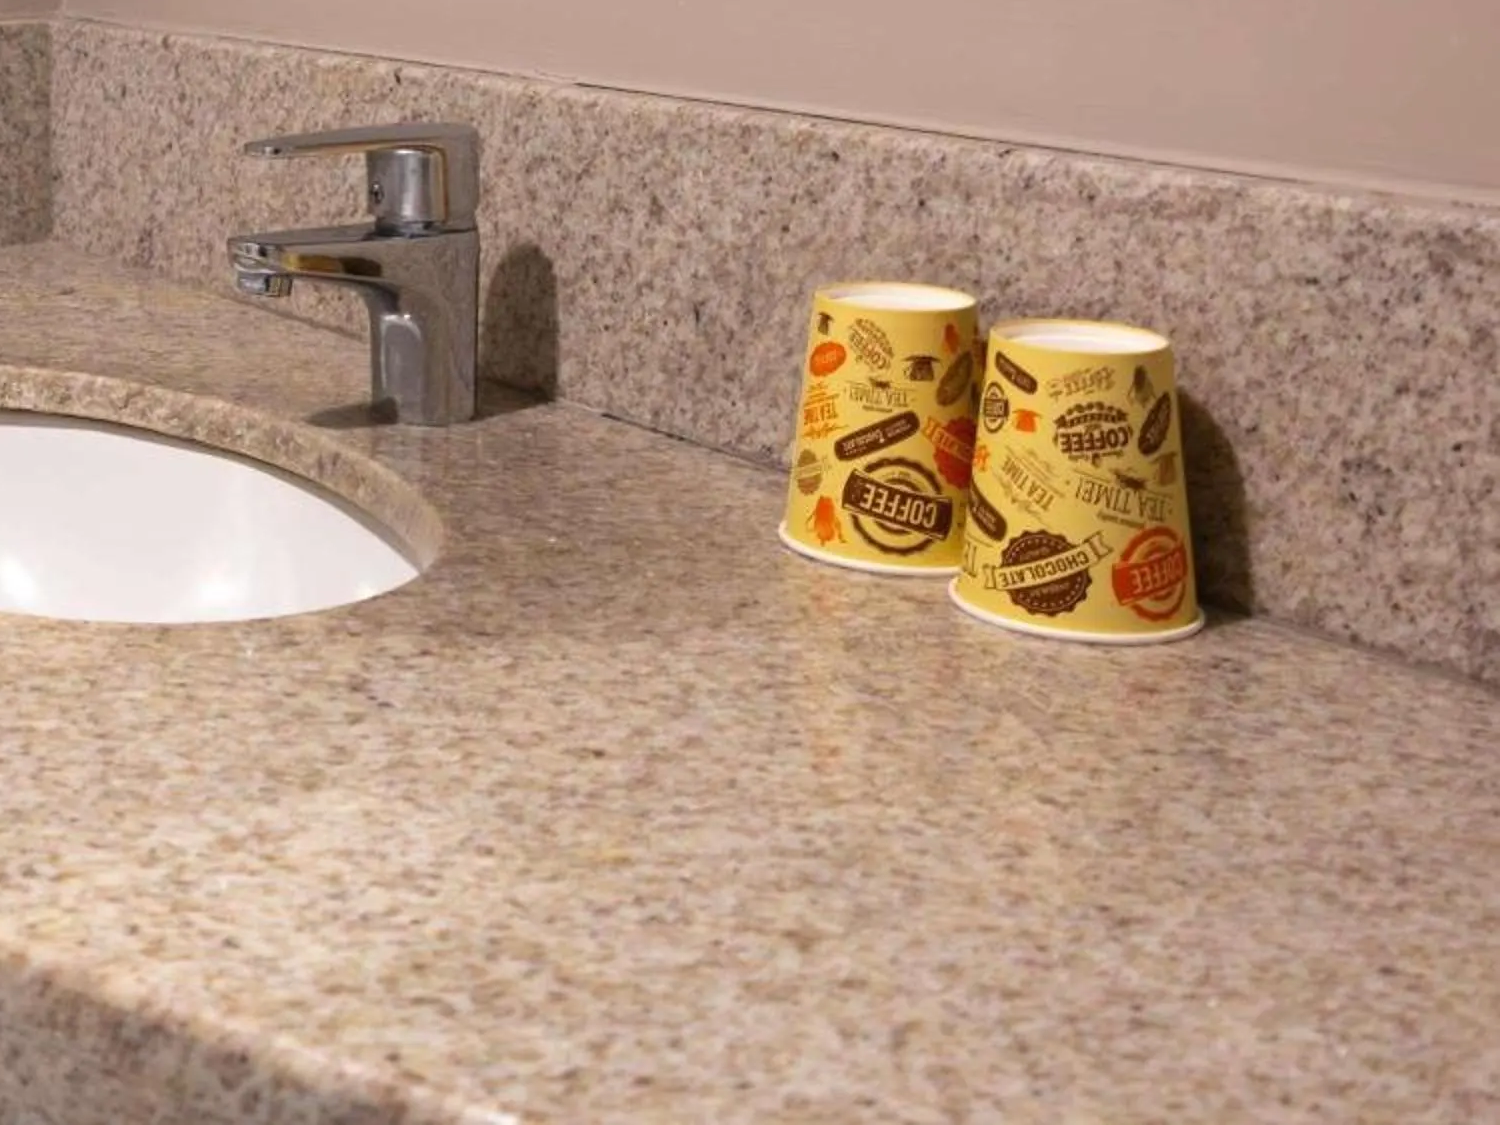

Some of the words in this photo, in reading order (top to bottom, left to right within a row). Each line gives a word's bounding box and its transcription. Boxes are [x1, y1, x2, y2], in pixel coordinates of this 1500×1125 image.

[1061, 427, 1130, 453] COFFEE
[1001, 458, 1030, 490] TIME
[860, 482, 938, 526] COFFEE
[1029, 481, 1055, 510] TEA
[1137, 490, 1167, 522] TEA
[999, 552, 1090, 587] CHOCOLATE
[1129, 553, 1184, 594] COFFEE
